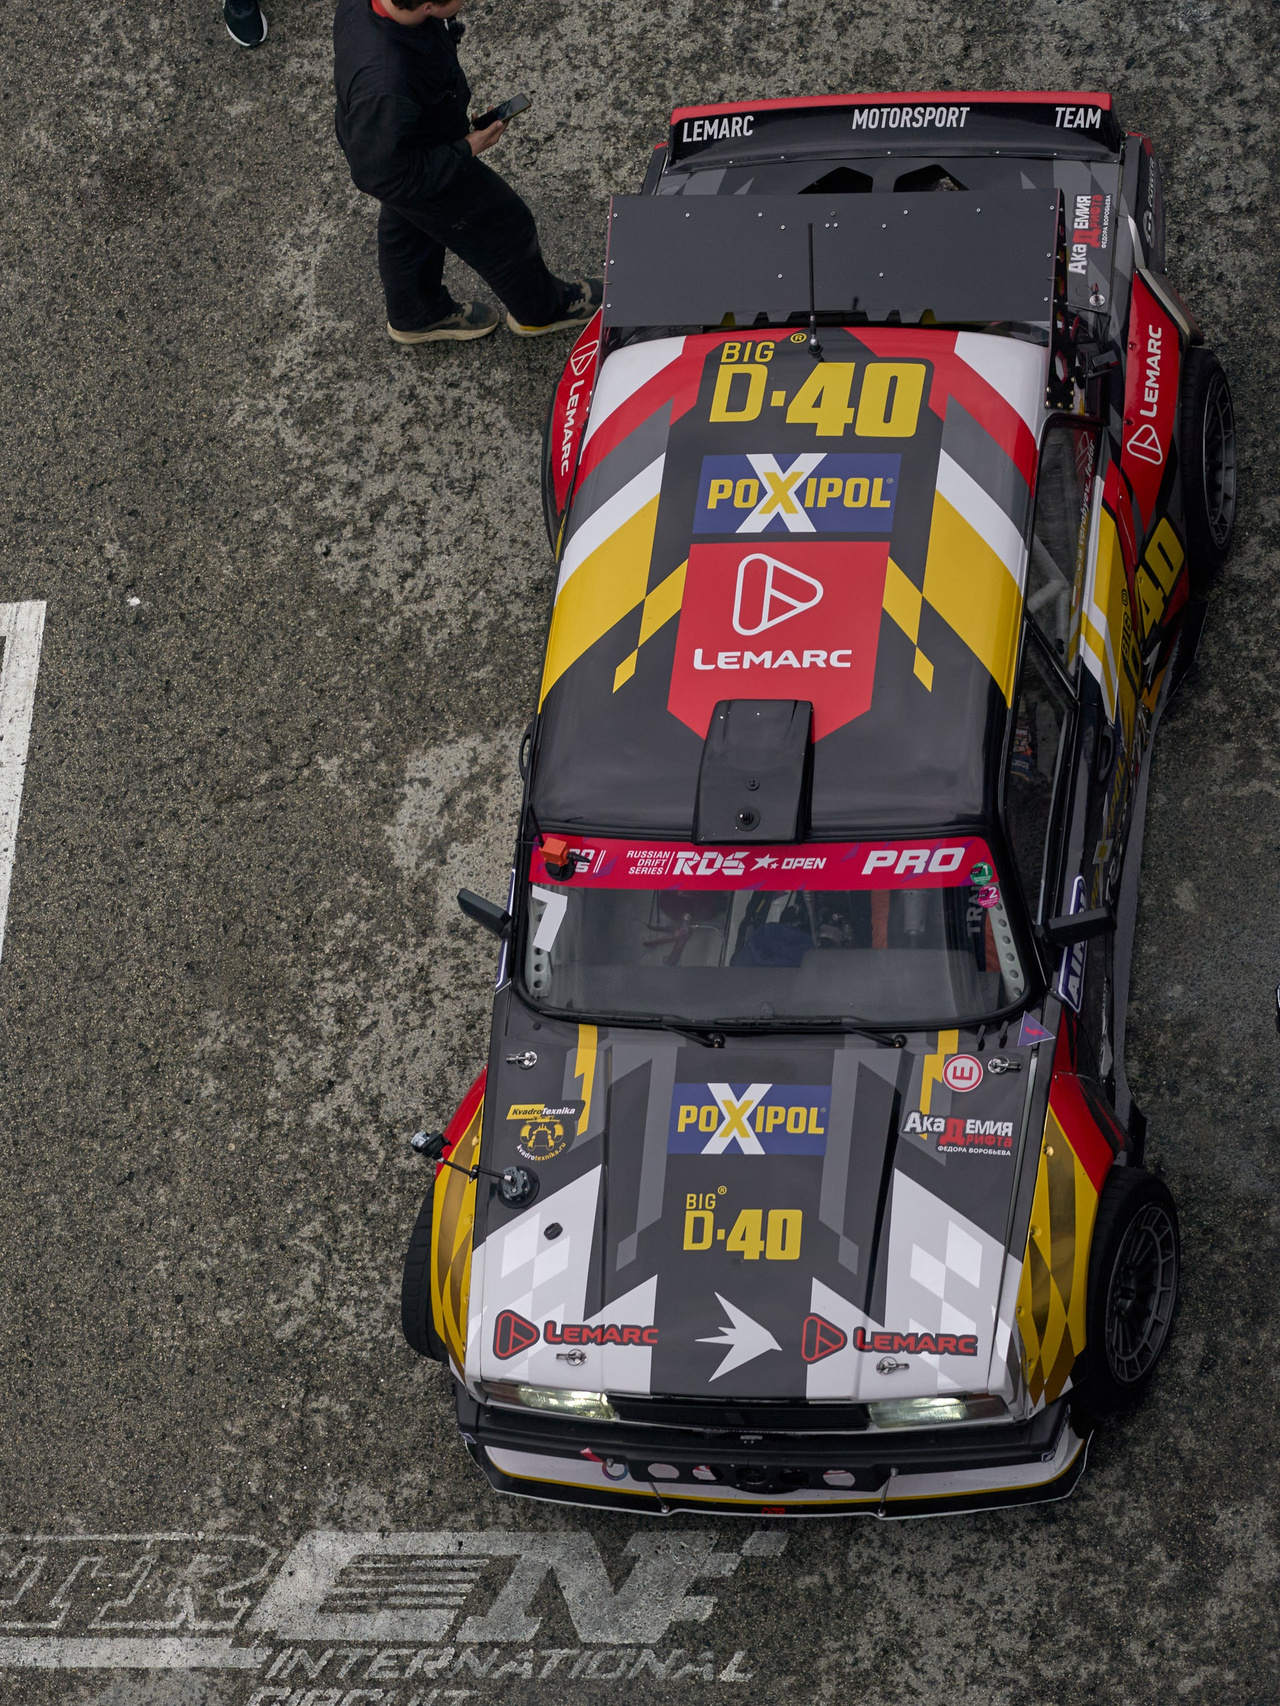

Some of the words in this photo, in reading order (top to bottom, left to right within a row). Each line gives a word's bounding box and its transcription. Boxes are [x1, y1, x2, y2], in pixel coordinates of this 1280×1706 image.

[682, 115, 754, 143] LEMARC
[851, 106, 970, 130] MOTORSPORT
[1054, 106, 1102, 129] TEAM
[720, 342, 774, 362] BIG
[1139, 324, 1163, 418] LEMARC
[560, 379, 585, 477] LEMARC
[707, 453, 891, 534] POXIPOL
[693, 648, 852, 671] LEMARC
[628, 867, 663, 875] SERIES
[781, 857, 826, 870] OPEN
[861, 847, 966, 875] PRO
[531, 884, 568, 952] 7
[677, 1083, 824, 1155] POXIPOL
[937, 1145, 967, 1154] ФЕДОРА
[968, 1147, 1011, 1156] ВОРОБЬЕВА
[686, 1193, 716, 1209] BIG
[547, 1321, 658, 1346] LEMARC
[858, 1328, 978, 1354] LEMARC
[265, 1647, 753, 1682] INTERNATIONAL
